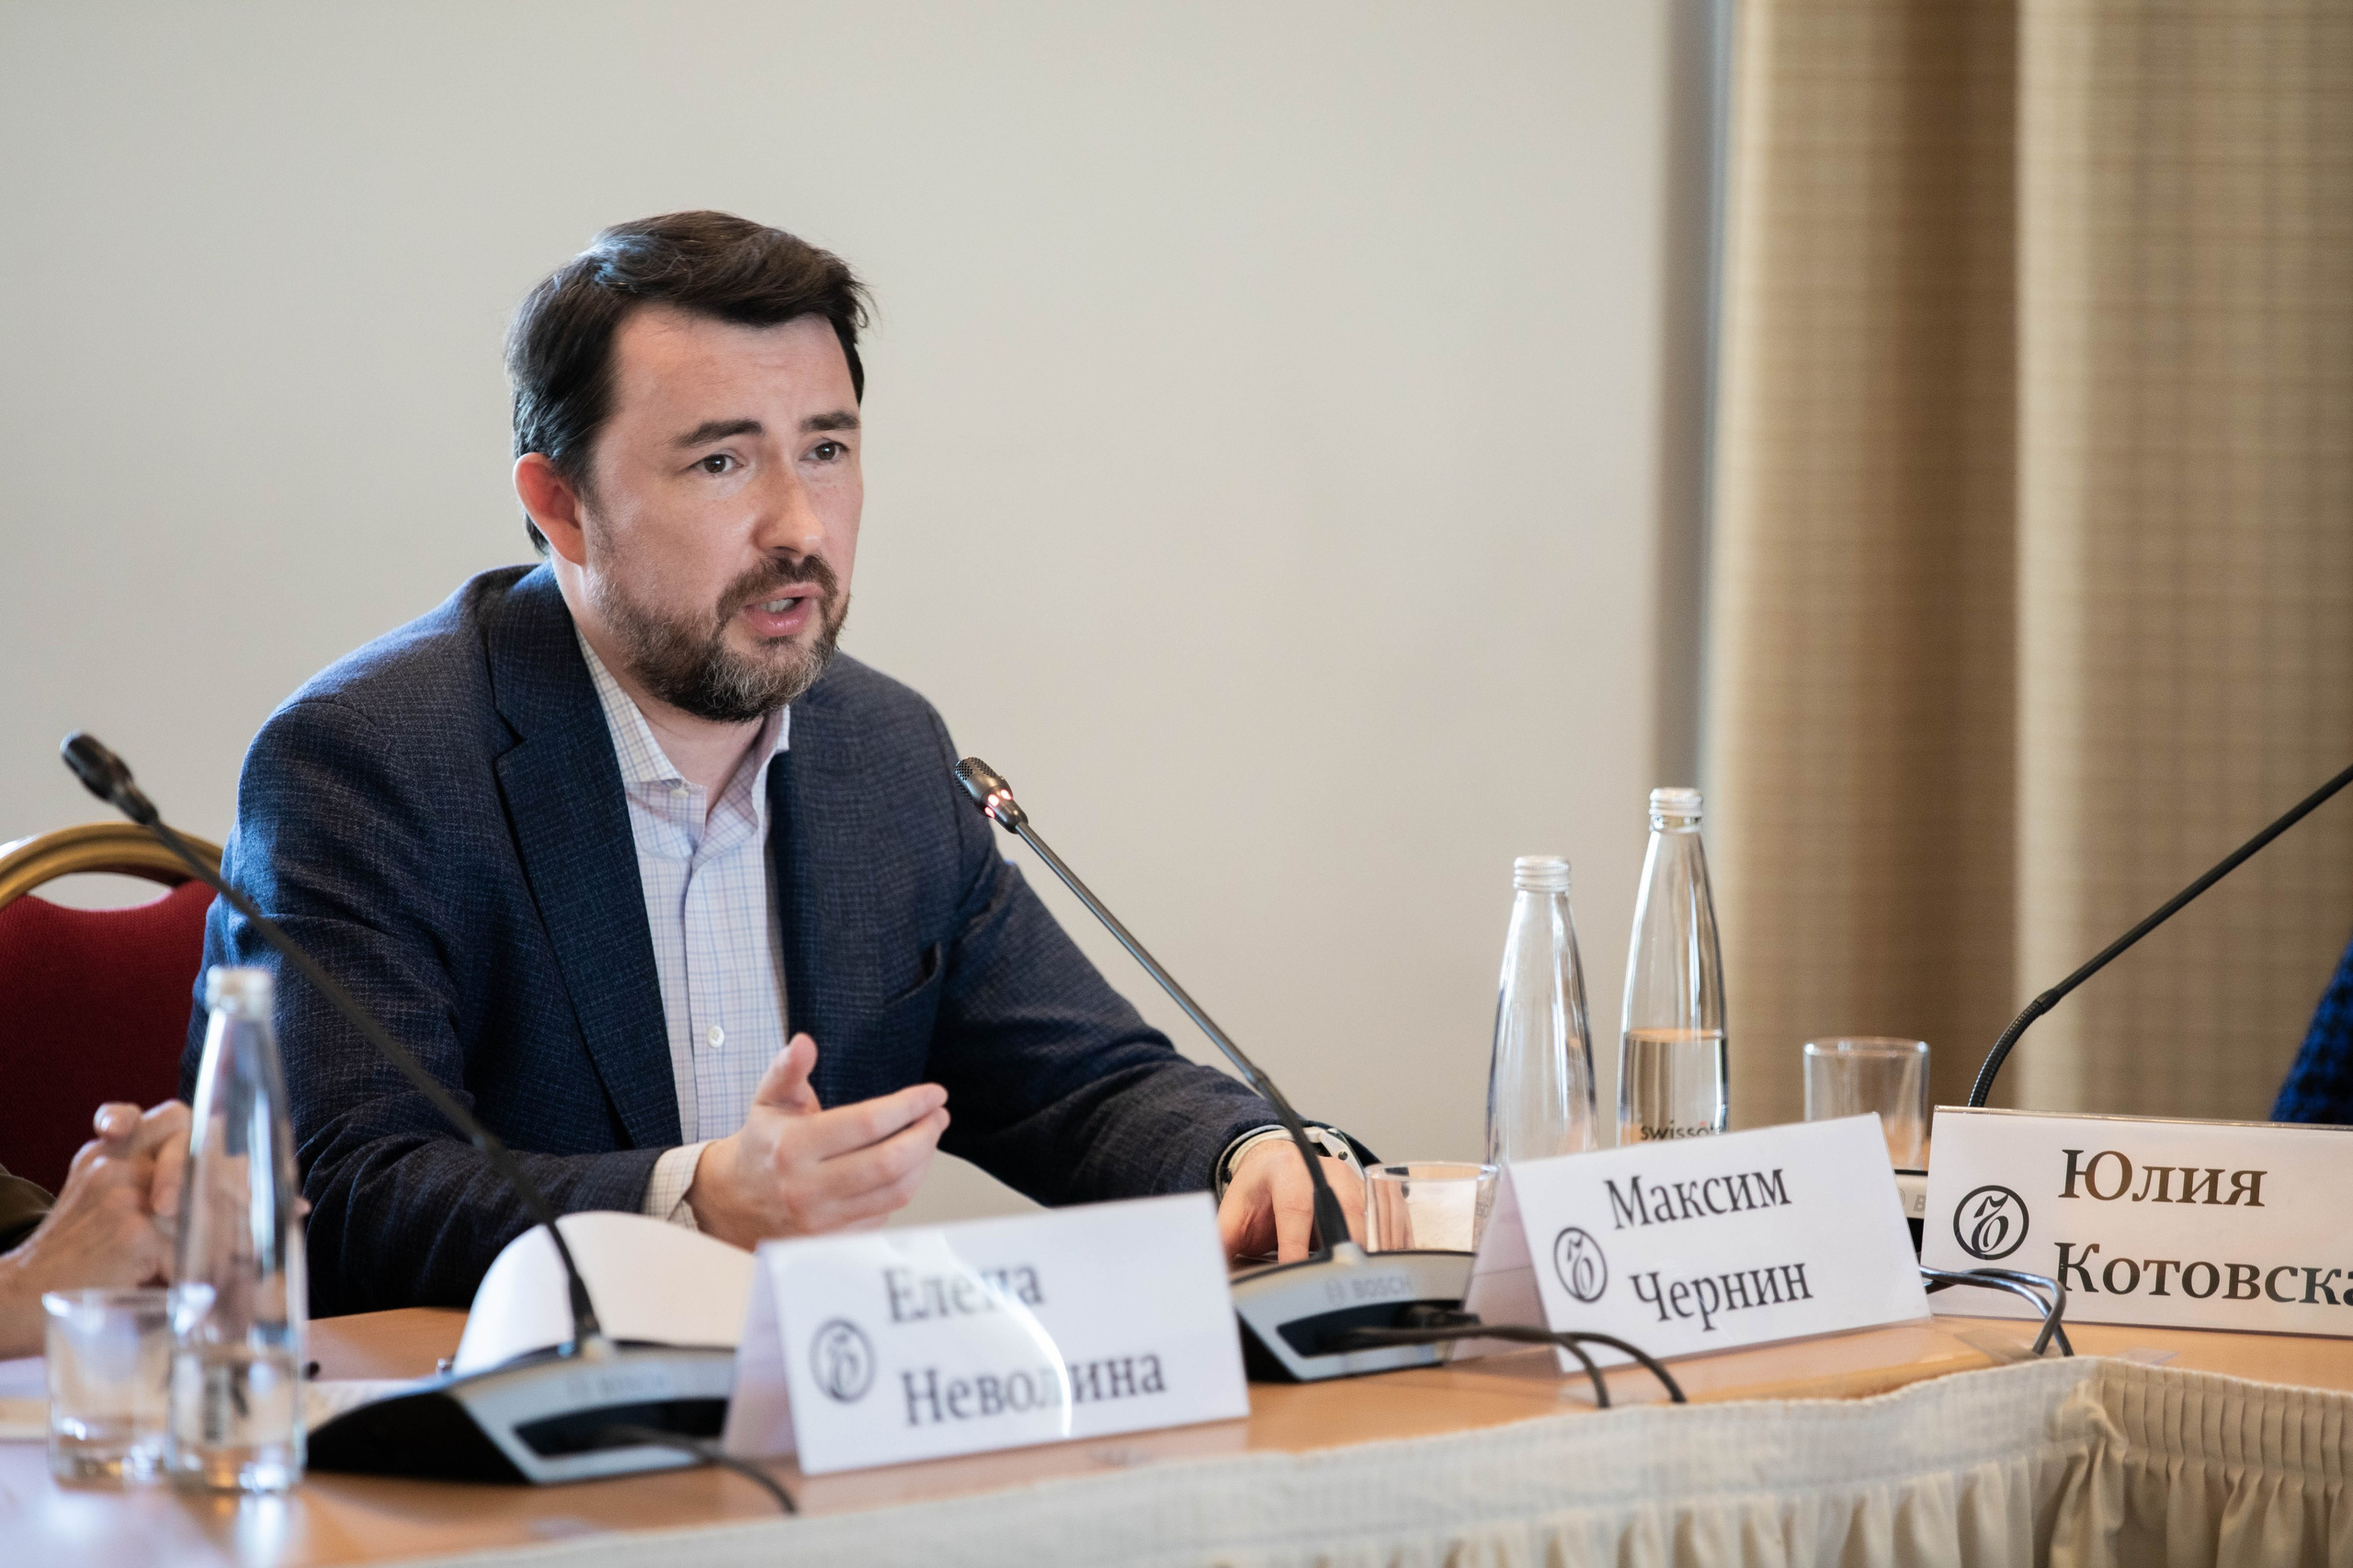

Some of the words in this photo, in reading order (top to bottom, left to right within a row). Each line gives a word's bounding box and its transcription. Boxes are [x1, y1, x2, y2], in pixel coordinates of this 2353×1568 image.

[1604, 1168, 1792, 1230] Максим
[2057, 1149, 2268, 1207] Юлия
[1629, 1263, 1813, 1331] Чернин
